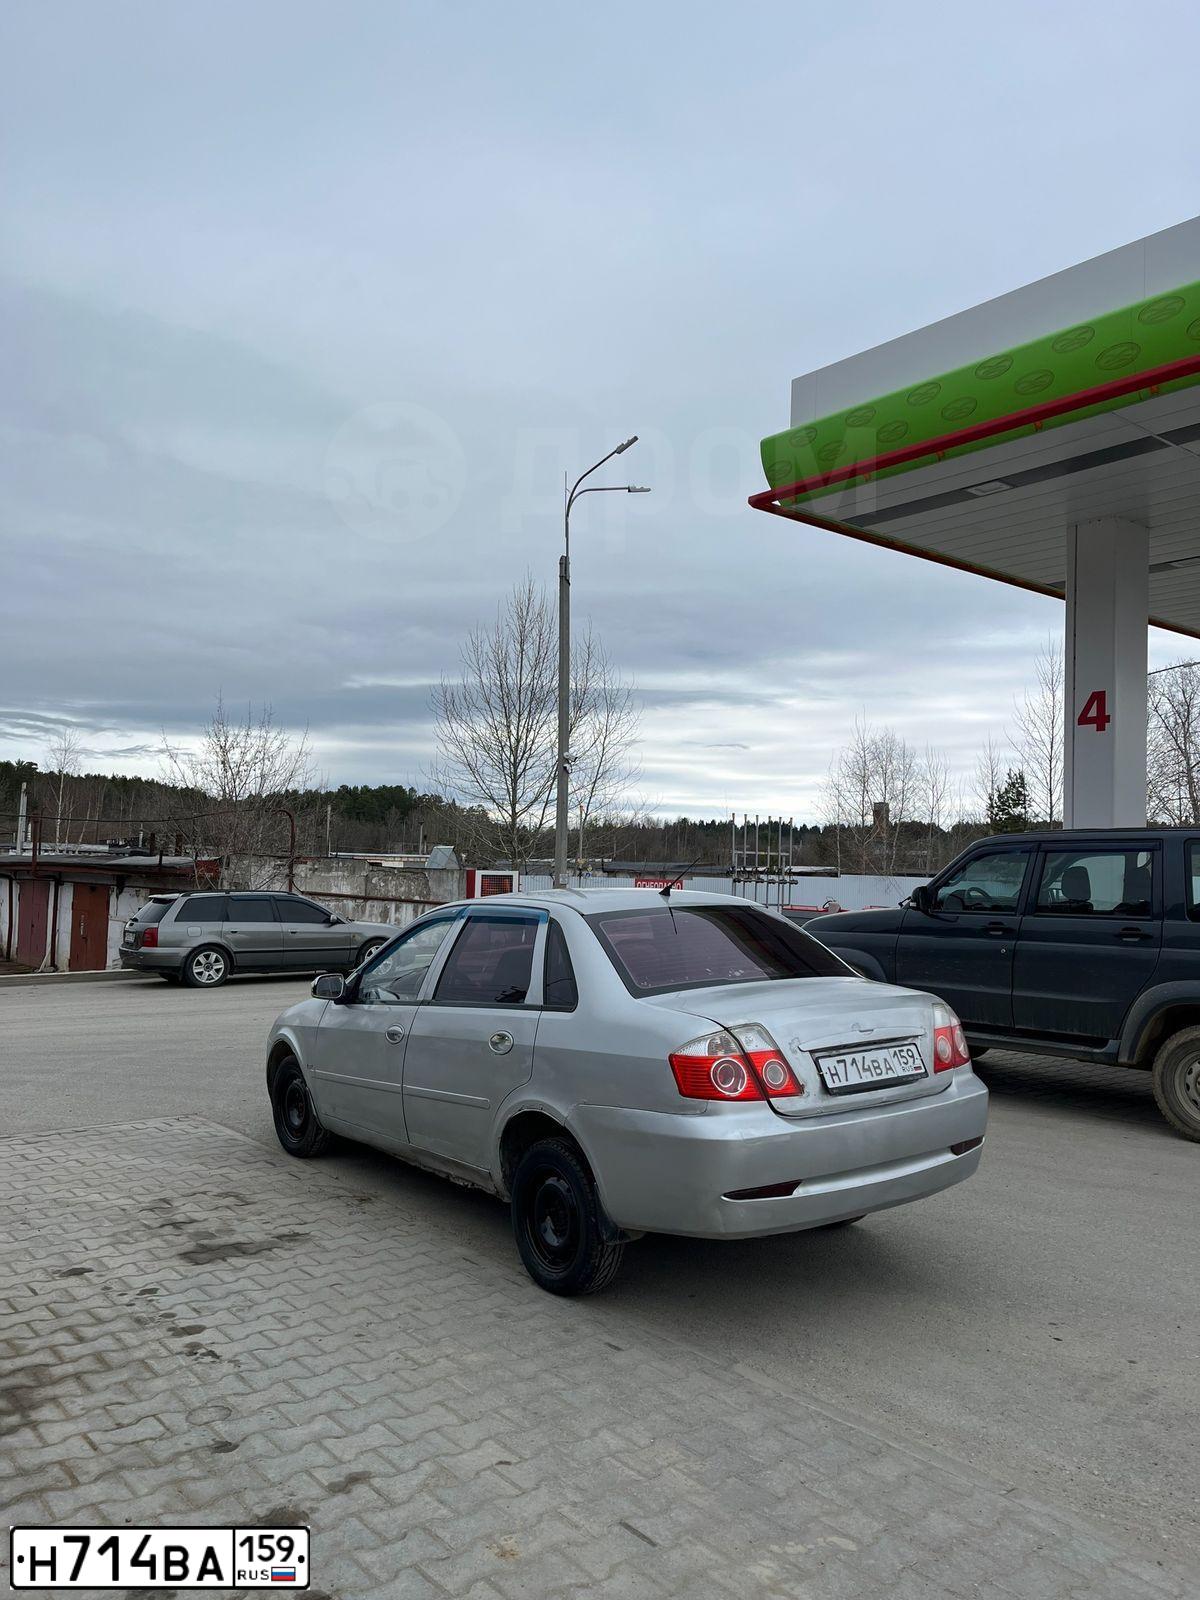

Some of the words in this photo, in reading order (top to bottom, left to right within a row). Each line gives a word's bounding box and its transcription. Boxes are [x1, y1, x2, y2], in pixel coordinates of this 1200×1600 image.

[1077, 690, 1111, 732] 4
[892, 1048, 916, 1067] 159
[902, 1065, 914, 1073] RUS
